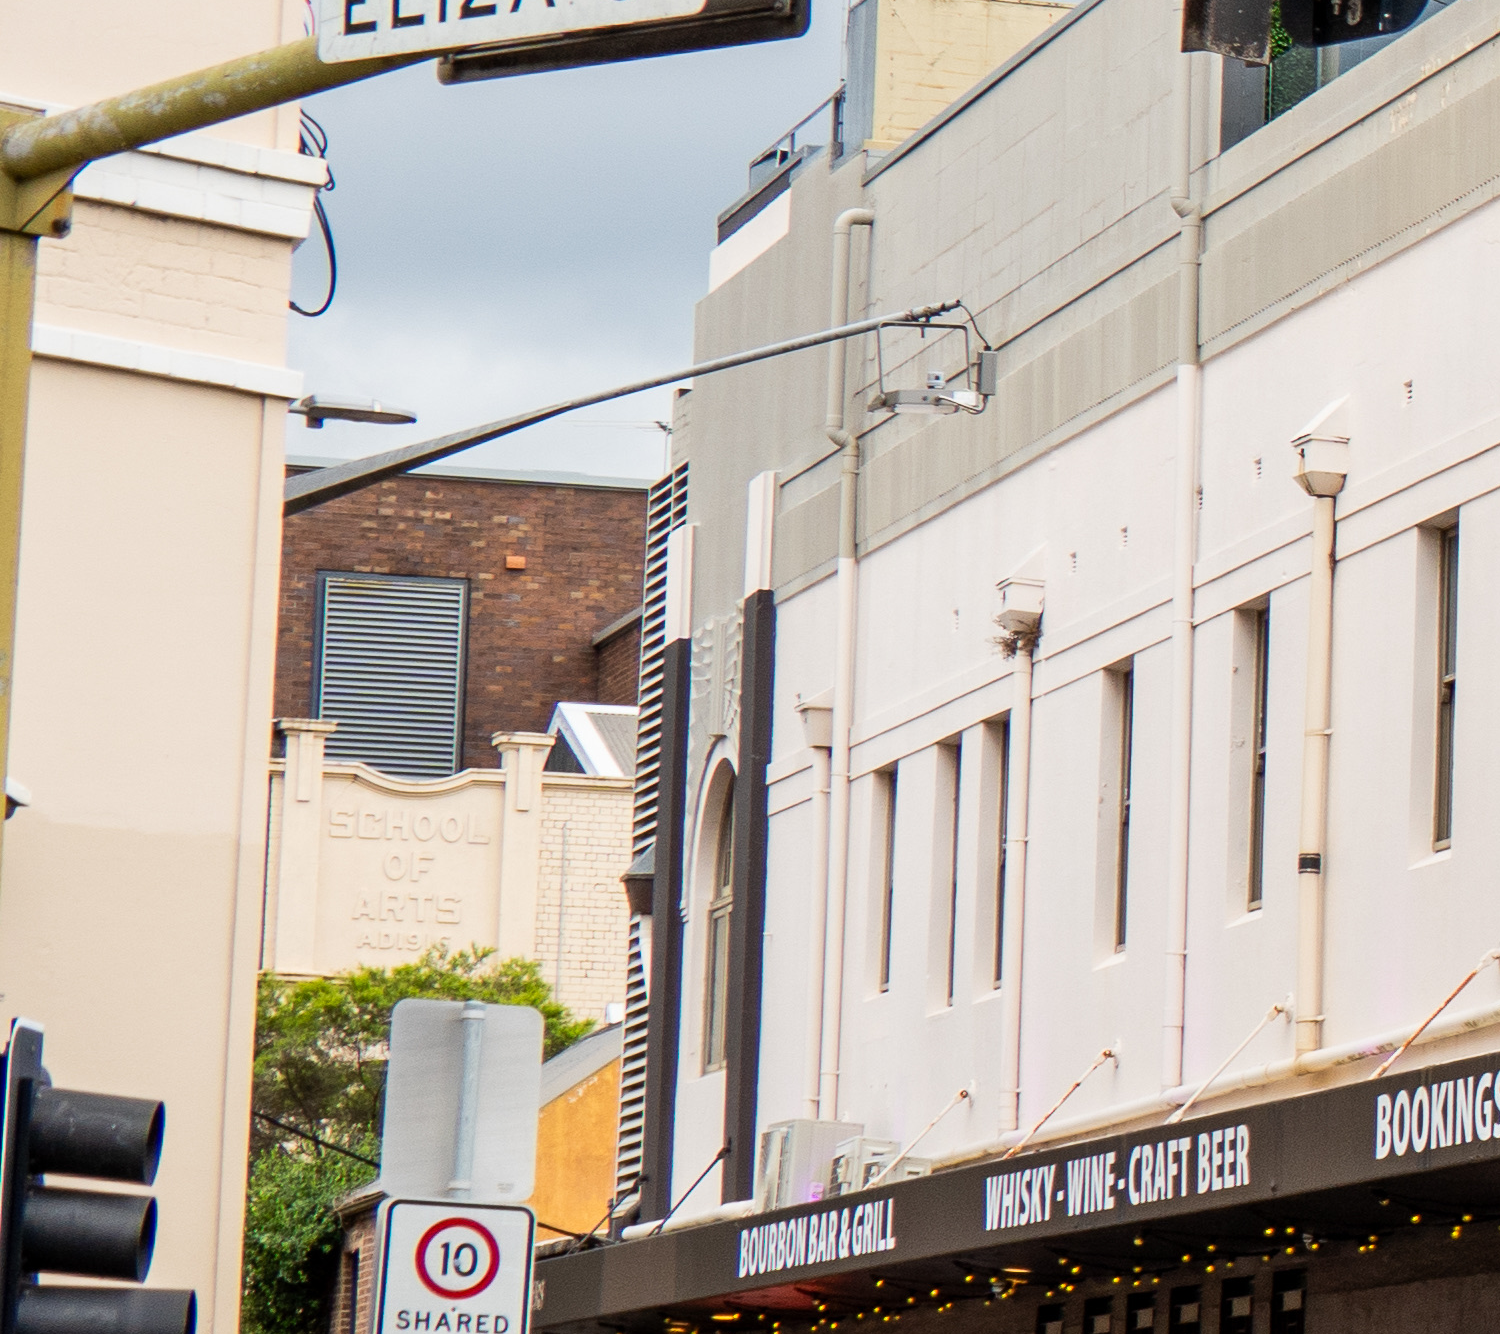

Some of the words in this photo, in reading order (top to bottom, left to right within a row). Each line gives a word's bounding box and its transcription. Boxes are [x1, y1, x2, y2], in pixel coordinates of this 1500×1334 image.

[328, 807, 491, 845] SCHOOL
[382, 850, 436, 882] OF
[351, 891, 463, 925] ARTS
[985, 1162, 1055, 1231] WHISKY
[1067, 1151, 1116, 1216] WINE
[1129, 1137, 1192, 1206] CRAFT
[1197, 1123, 1252, 1194] BEER
[738, 1215, 806, 1279] BOURBON
[808, 1208, 839, 1264] BAR
[840, 1213, 853, 1260] &
[852, 1198, 896, 1255] GRILL
[440, 1241, 479, 1278] 10
